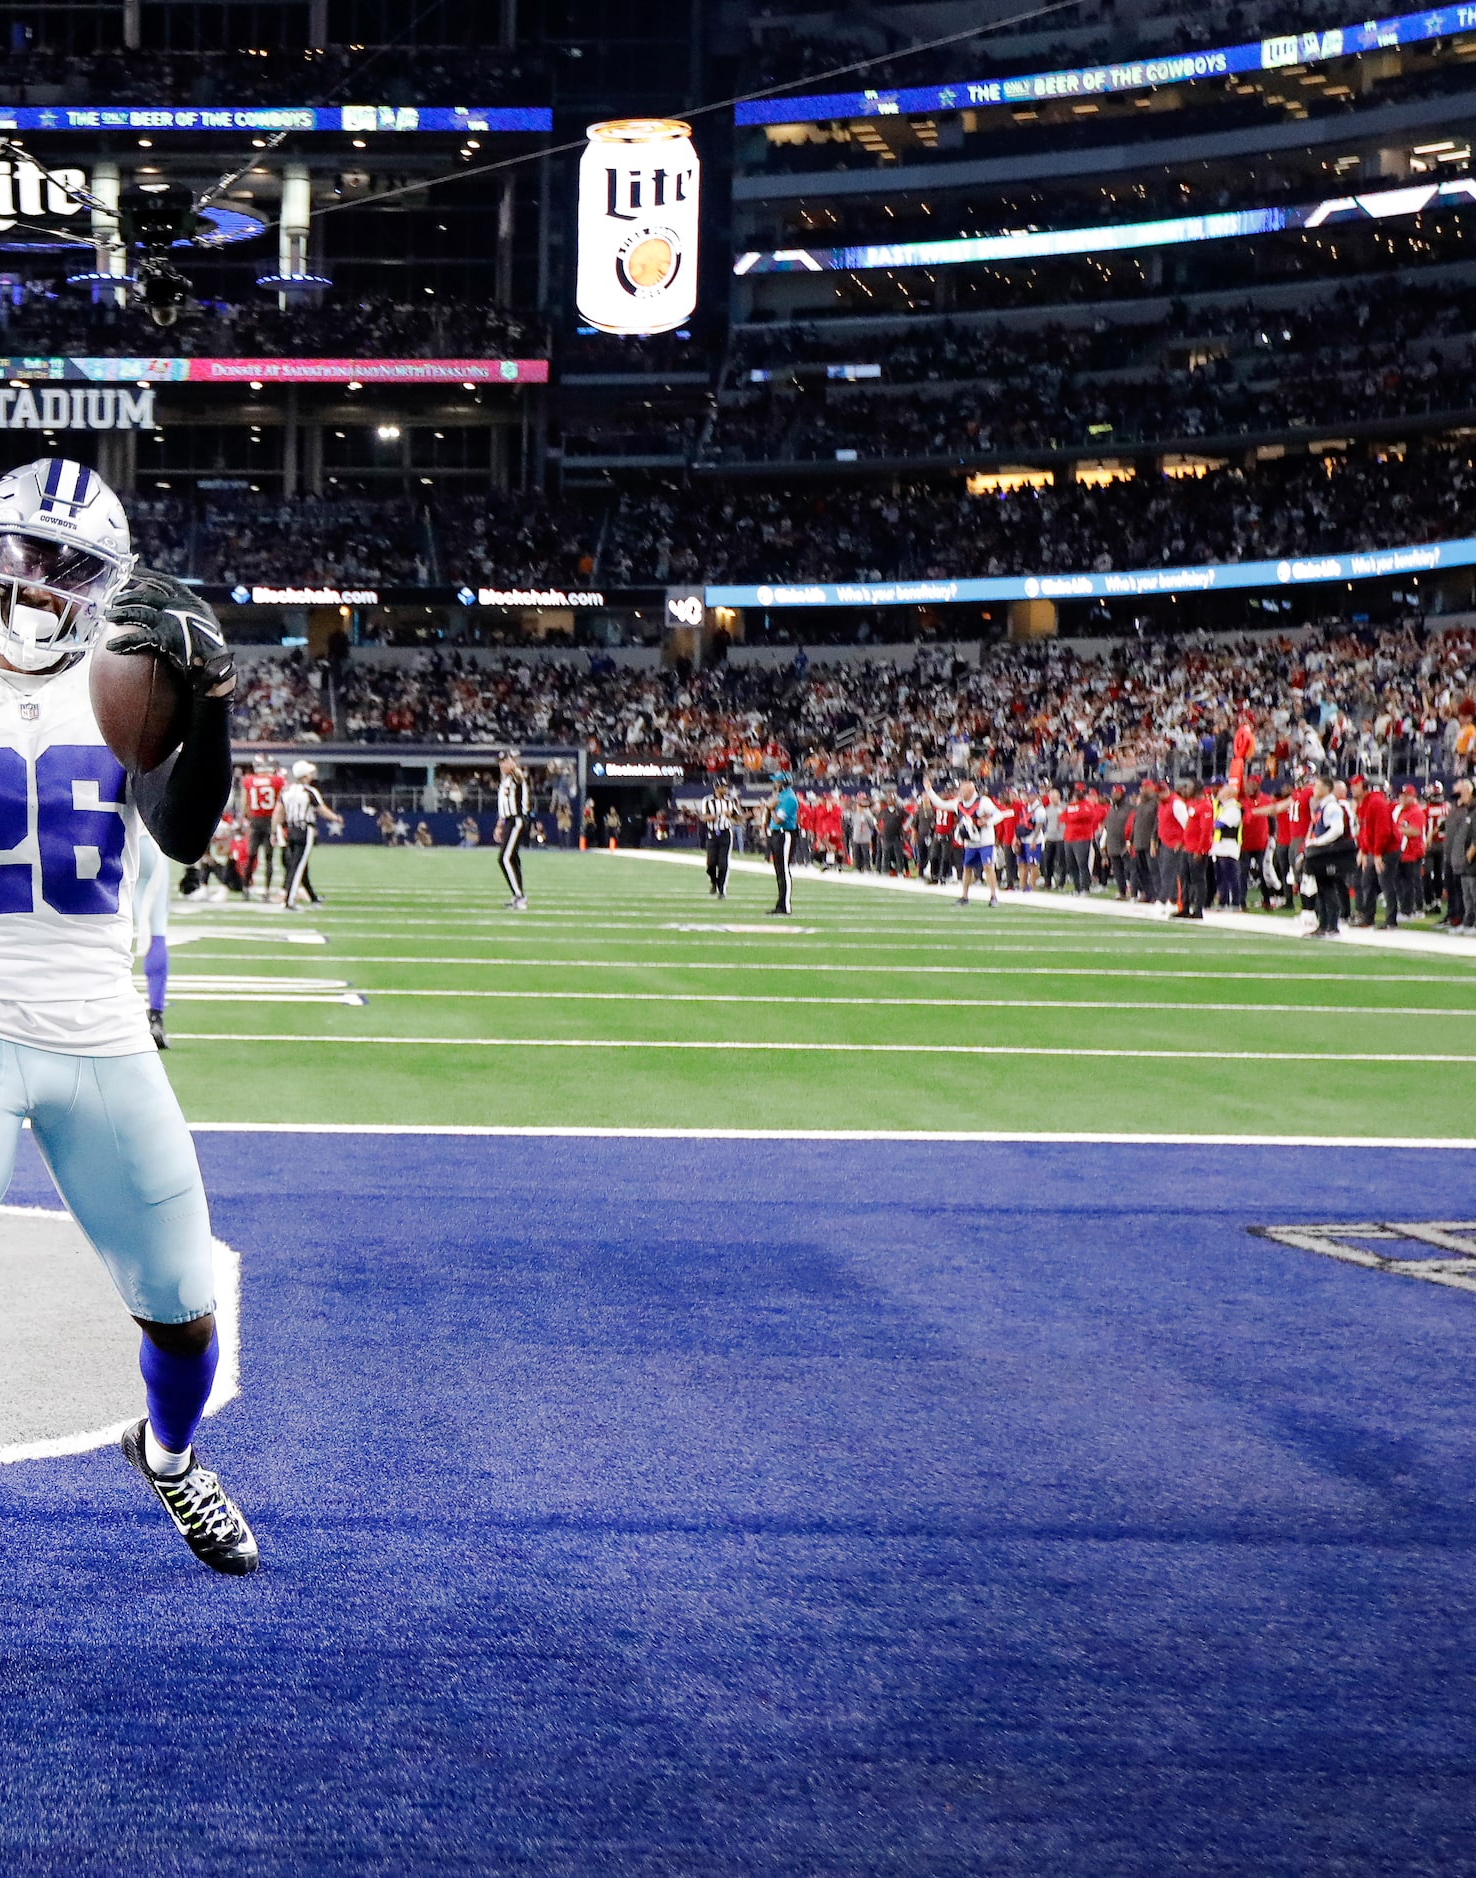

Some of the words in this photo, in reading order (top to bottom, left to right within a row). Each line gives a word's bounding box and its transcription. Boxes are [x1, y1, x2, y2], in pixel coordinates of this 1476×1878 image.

[967, 82, 1001, 103] THE
[1033, 75, 1079, 96] BEER
[1082, 72, 1107, 90] OF
[1109, 67, 1143, 88] THE
[1145, 53, 1227, 82] COWBOYS
[67, 112, 100, 127] THE
[130, 111, 173, 127] BEER
[175, 111, 199, 127] OF
[199, 112, 233, 127] THE
[234, 112, 312, 127] COWBOYS
[605, 167, 693, 221] Lite
[40, 514, 78, 530] COWBOYS
[1375, 557, 1394, 576] your
[1394, 547, 1441, 569] beneficiary?
[1137, 577, 1159, 593] your
[1158, 569, 1216, 590] beneficiary?
[252, 586, 379, 605] Blockchain.com
[478, 588, 604, 606] Blockchain.com
[871, 588, 896, 605] your
[896, 582, 958, 602] beneficiary?
[606, 763, 684, 777] Blockchain.com
[249, 786, 275, 811] 13
